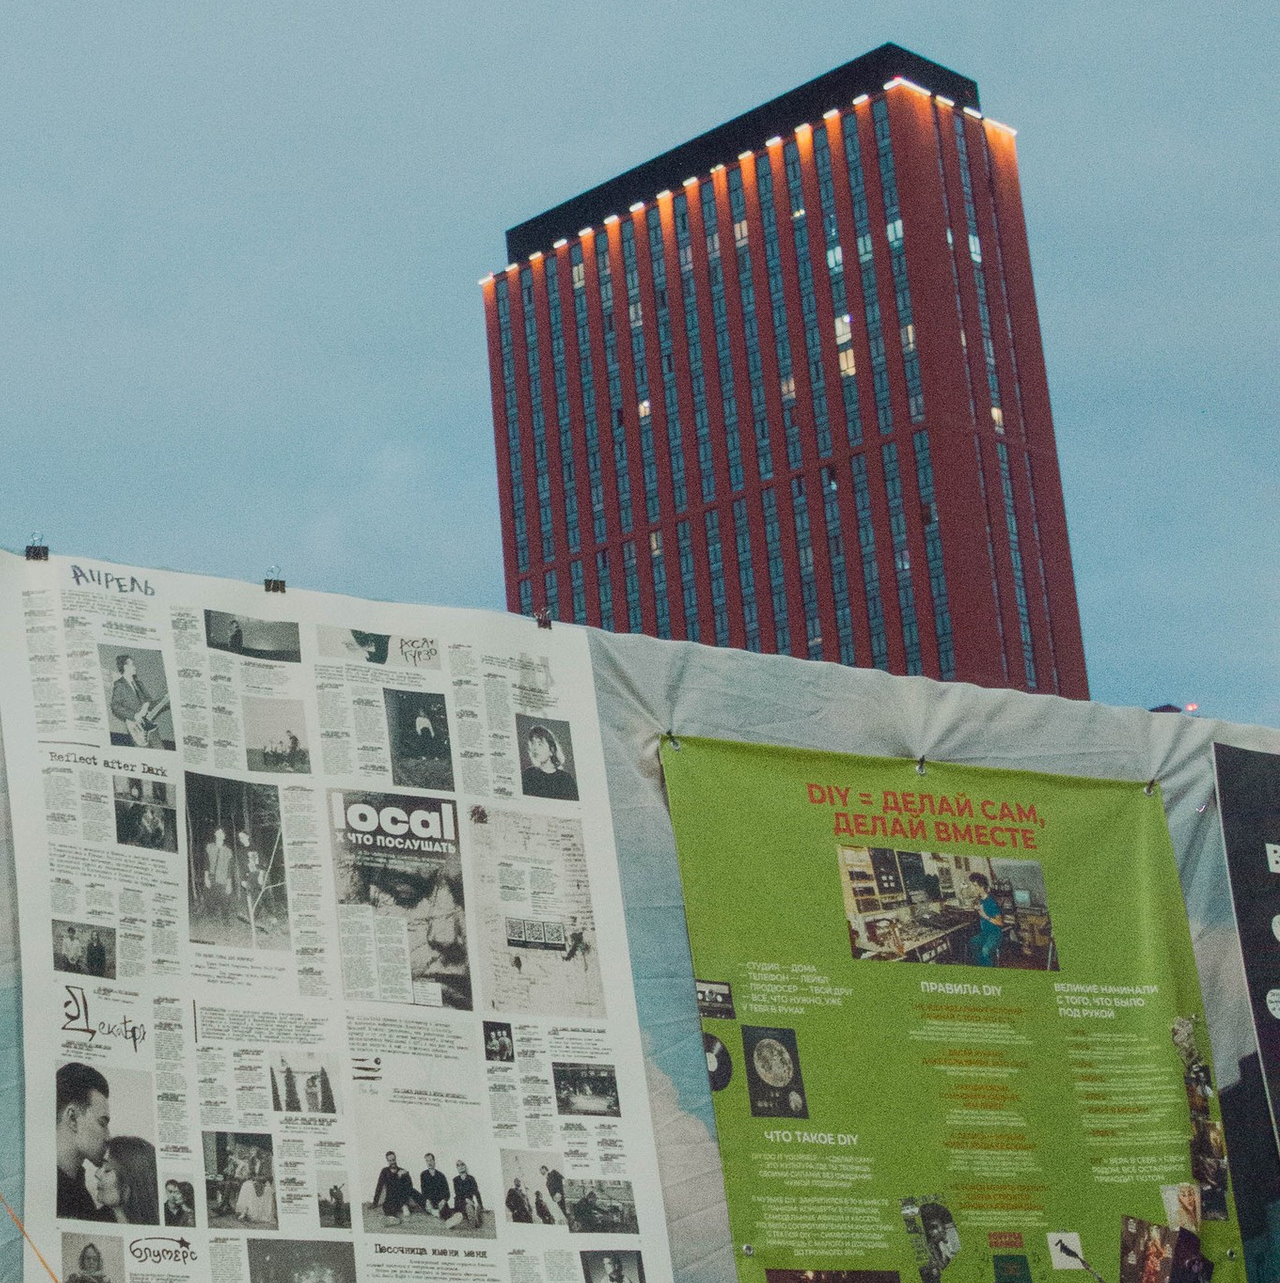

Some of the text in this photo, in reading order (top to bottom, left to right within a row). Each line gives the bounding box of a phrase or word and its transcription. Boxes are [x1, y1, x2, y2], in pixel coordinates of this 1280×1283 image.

[70, 565, 156, 597] АПРЕЛЬ
[48, 751, 168, 778] Reflect after Dark
[806, 783, 851, 807] DIY
[882, 791, 974, 818] ДЕЛАЙ
[980, 800, 1046, 829] САМ,
[331, 792, 455, 841] local
[833, 811, 1037, 850] ДЕЛАЙ ВМЕСТЕ
[347, 832, 373, 845] ЧТО
[376, 836, 456, 854] ПОСЛУШАТЬ
[791, 964, 816, 973] ДОМА
[920, 981, 1002, 996] ПРАВИЛА DIY
[1054, 982, 1158, 995] ВЕЛИКИЕ НАЧИНАЛИ
[1093, 997, 1112, 1006] ЧТО
[1058, 1007, 1080, 1018] ПОД
[764, 1130, 859, 1146] ЧТО ТАКОЕ DIY
[374, 1243, 487, 1259] Песочница имени меня
